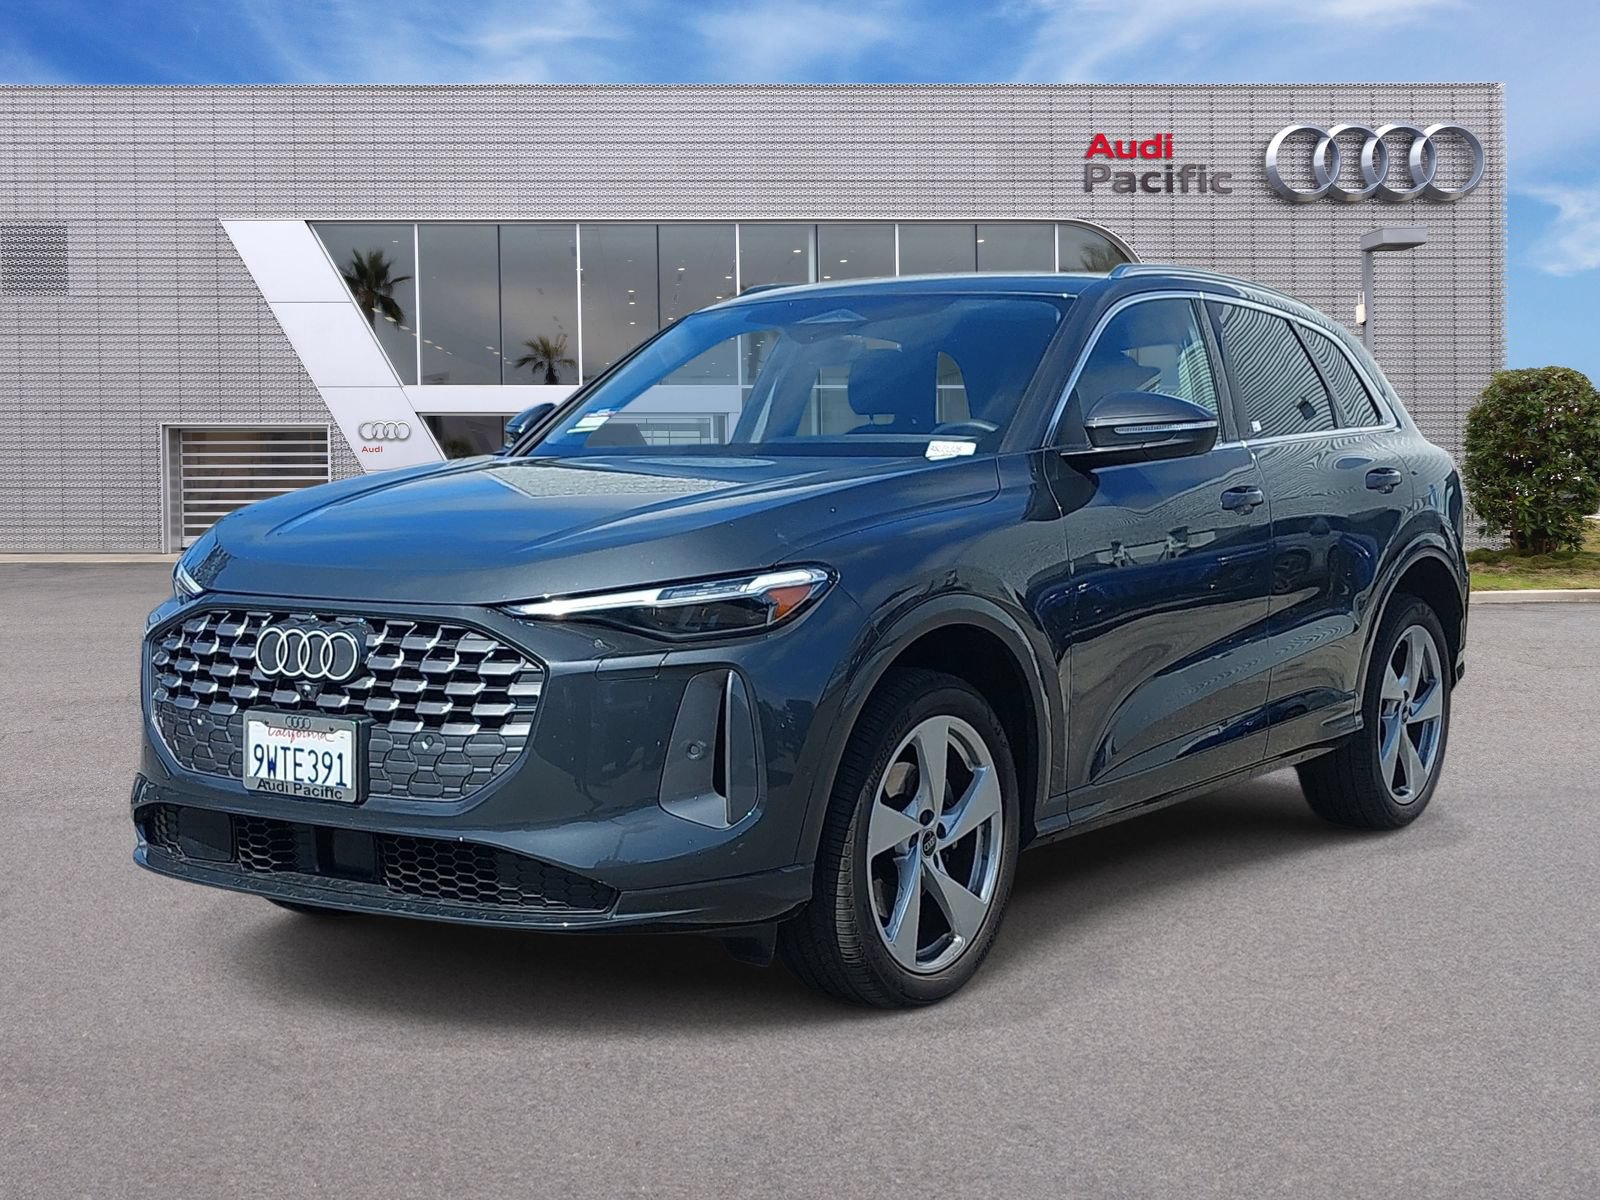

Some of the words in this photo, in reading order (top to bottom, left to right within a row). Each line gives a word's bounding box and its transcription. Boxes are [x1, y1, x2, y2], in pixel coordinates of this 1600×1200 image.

[1084, 132, 1173, 159] Audi
[1084, 163, 1233, 194] Pacific
[253, 743, 347, 787] 9WTE391
[256, 778, 289, 793] Audi
[293, 782, 343, 800] Pacific
